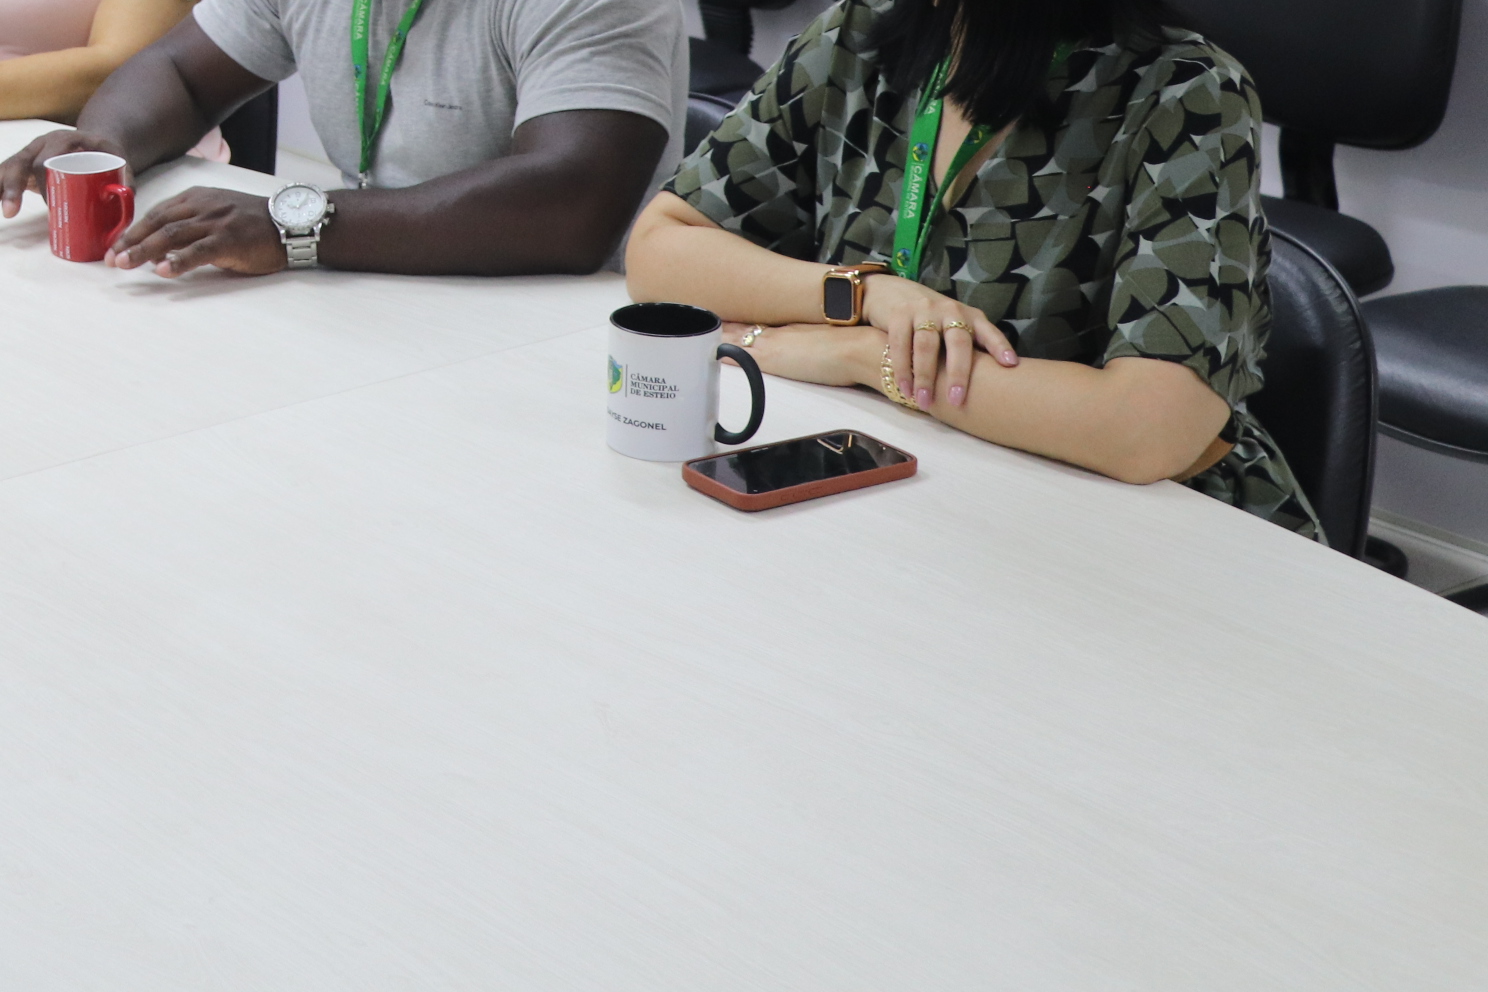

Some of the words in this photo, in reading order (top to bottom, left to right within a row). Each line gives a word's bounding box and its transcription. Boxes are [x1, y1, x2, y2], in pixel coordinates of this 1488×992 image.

[906, 165, 923, 219] CÂMARA
[630, 373, 666, 384] CÂMARA
[630, 380, 679, 392] MUNICIPAL
[630, 387, 641, 396] DE
[643, 390, 676, 399] ESTEIO
[623, 416, 667, 430] ZAGONEL
